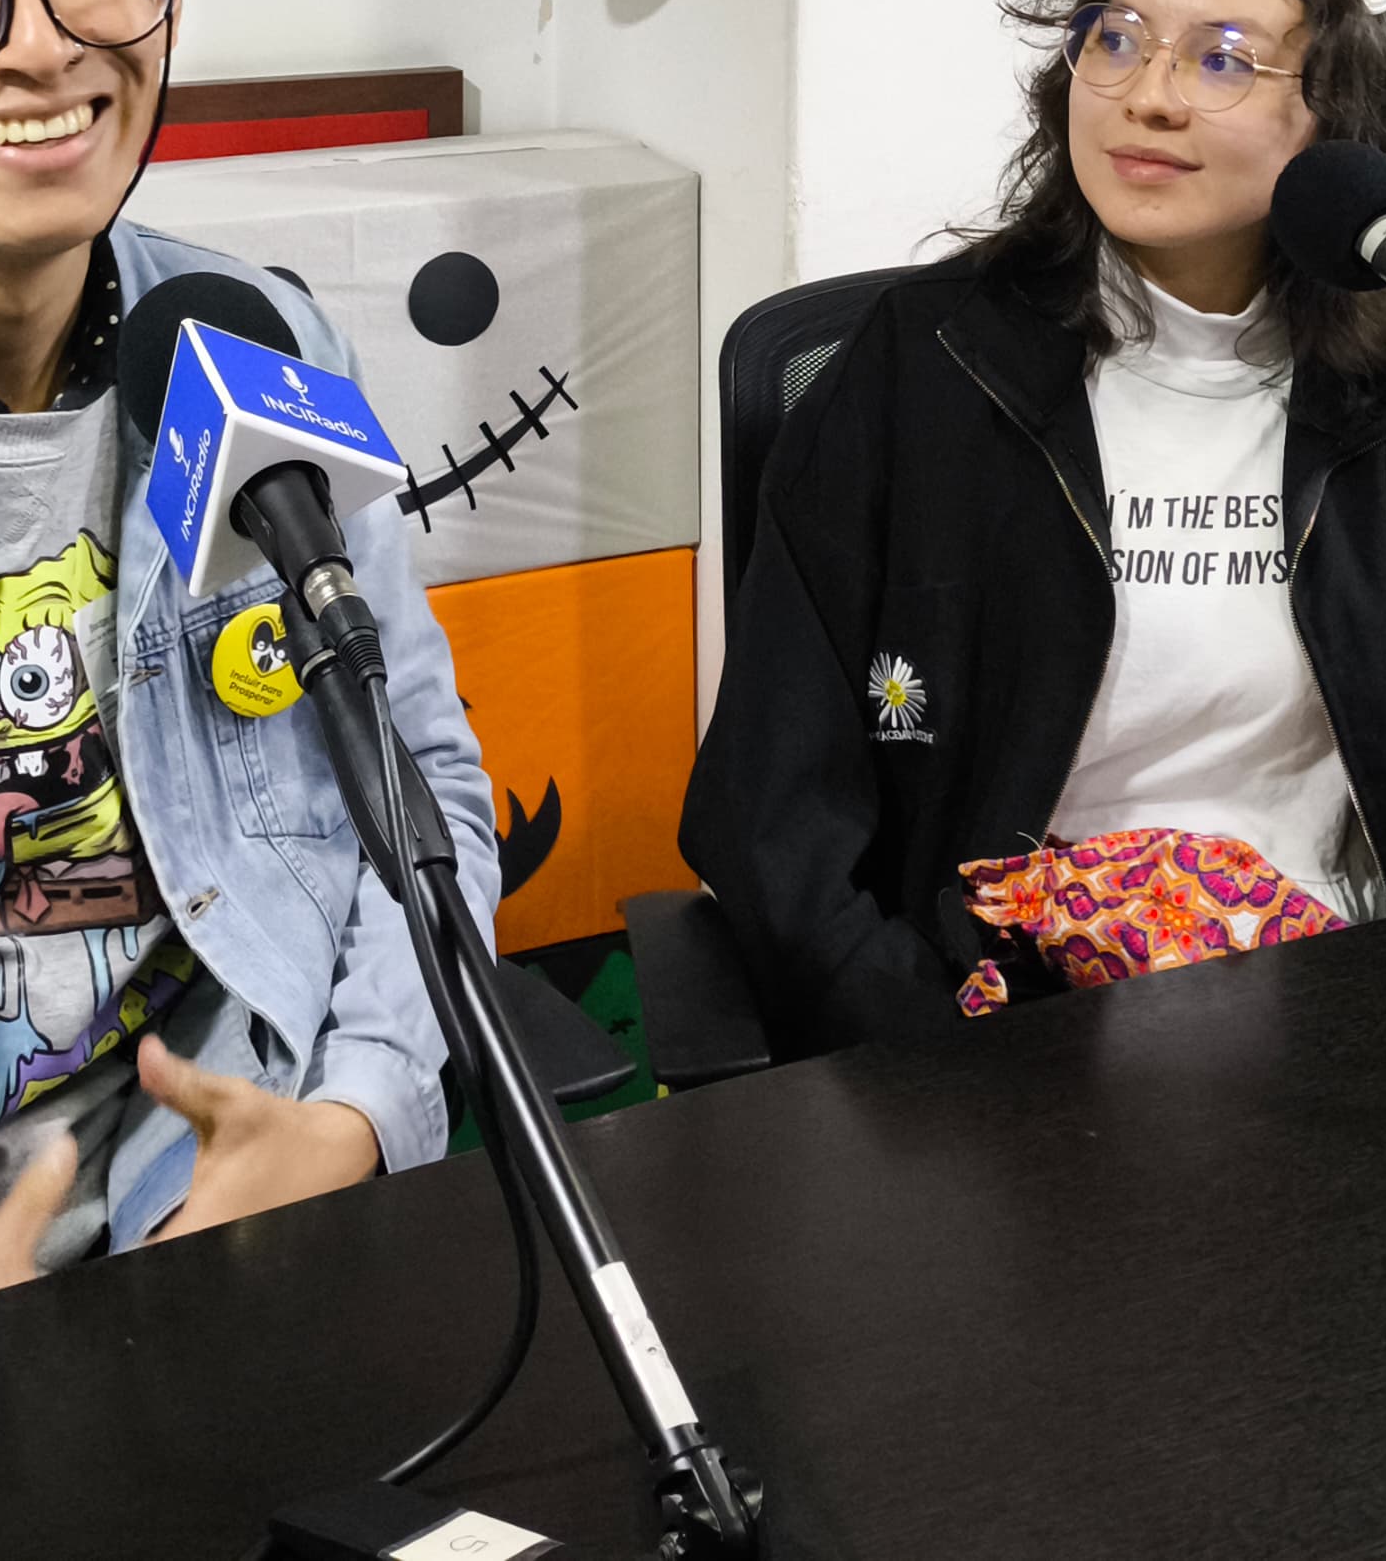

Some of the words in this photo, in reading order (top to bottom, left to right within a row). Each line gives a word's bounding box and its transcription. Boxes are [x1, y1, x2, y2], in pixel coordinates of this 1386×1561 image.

[260, 392, 368, 442] INCIRadio
[180, 428, 211, 542] INCIRadio
[1163, 495, 1218, 529] THE
[1224, 494, 1285, 529] BES
[1182, 551, 1219, 585] OF
[229, 669, 262, 688] Incluir
[260, 683, 283, 698] para
[229, 681, 275, 706] Prosperar
